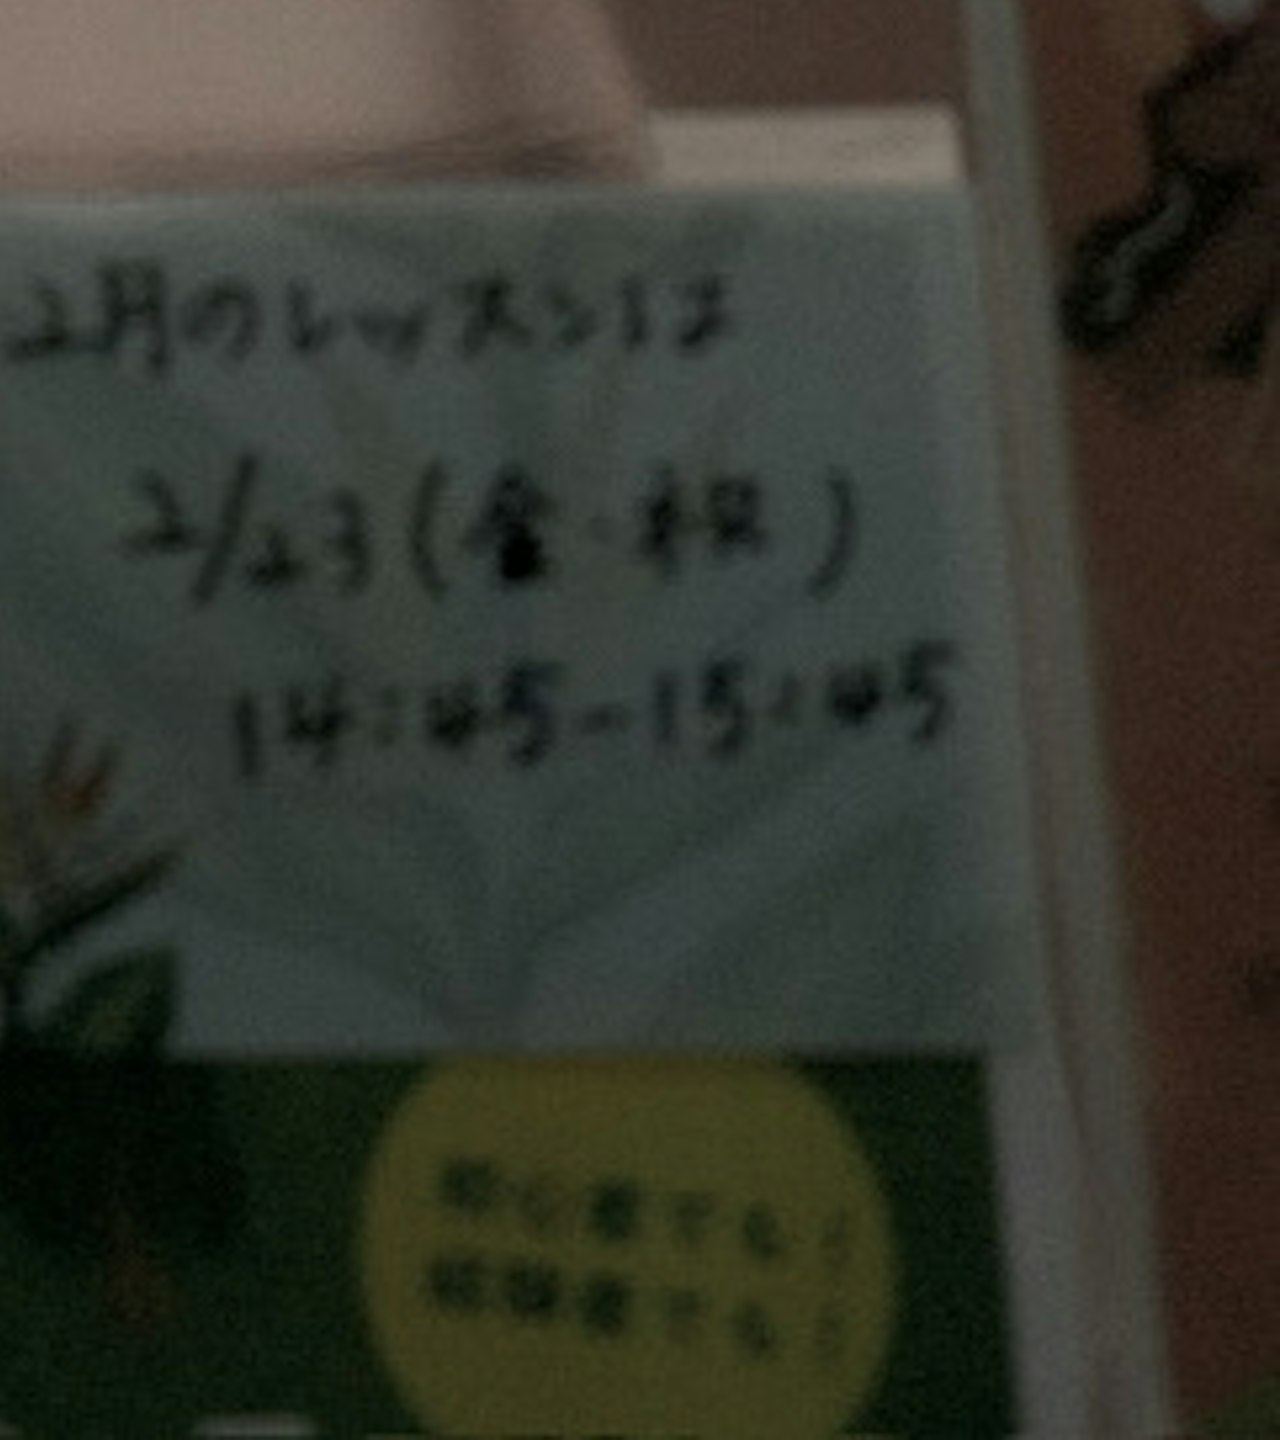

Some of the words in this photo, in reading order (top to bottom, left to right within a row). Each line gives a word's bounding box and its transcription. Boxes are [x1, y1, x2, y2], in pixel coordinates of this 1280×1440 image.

[8, 258, 730, 377] 2月のレッスンは
